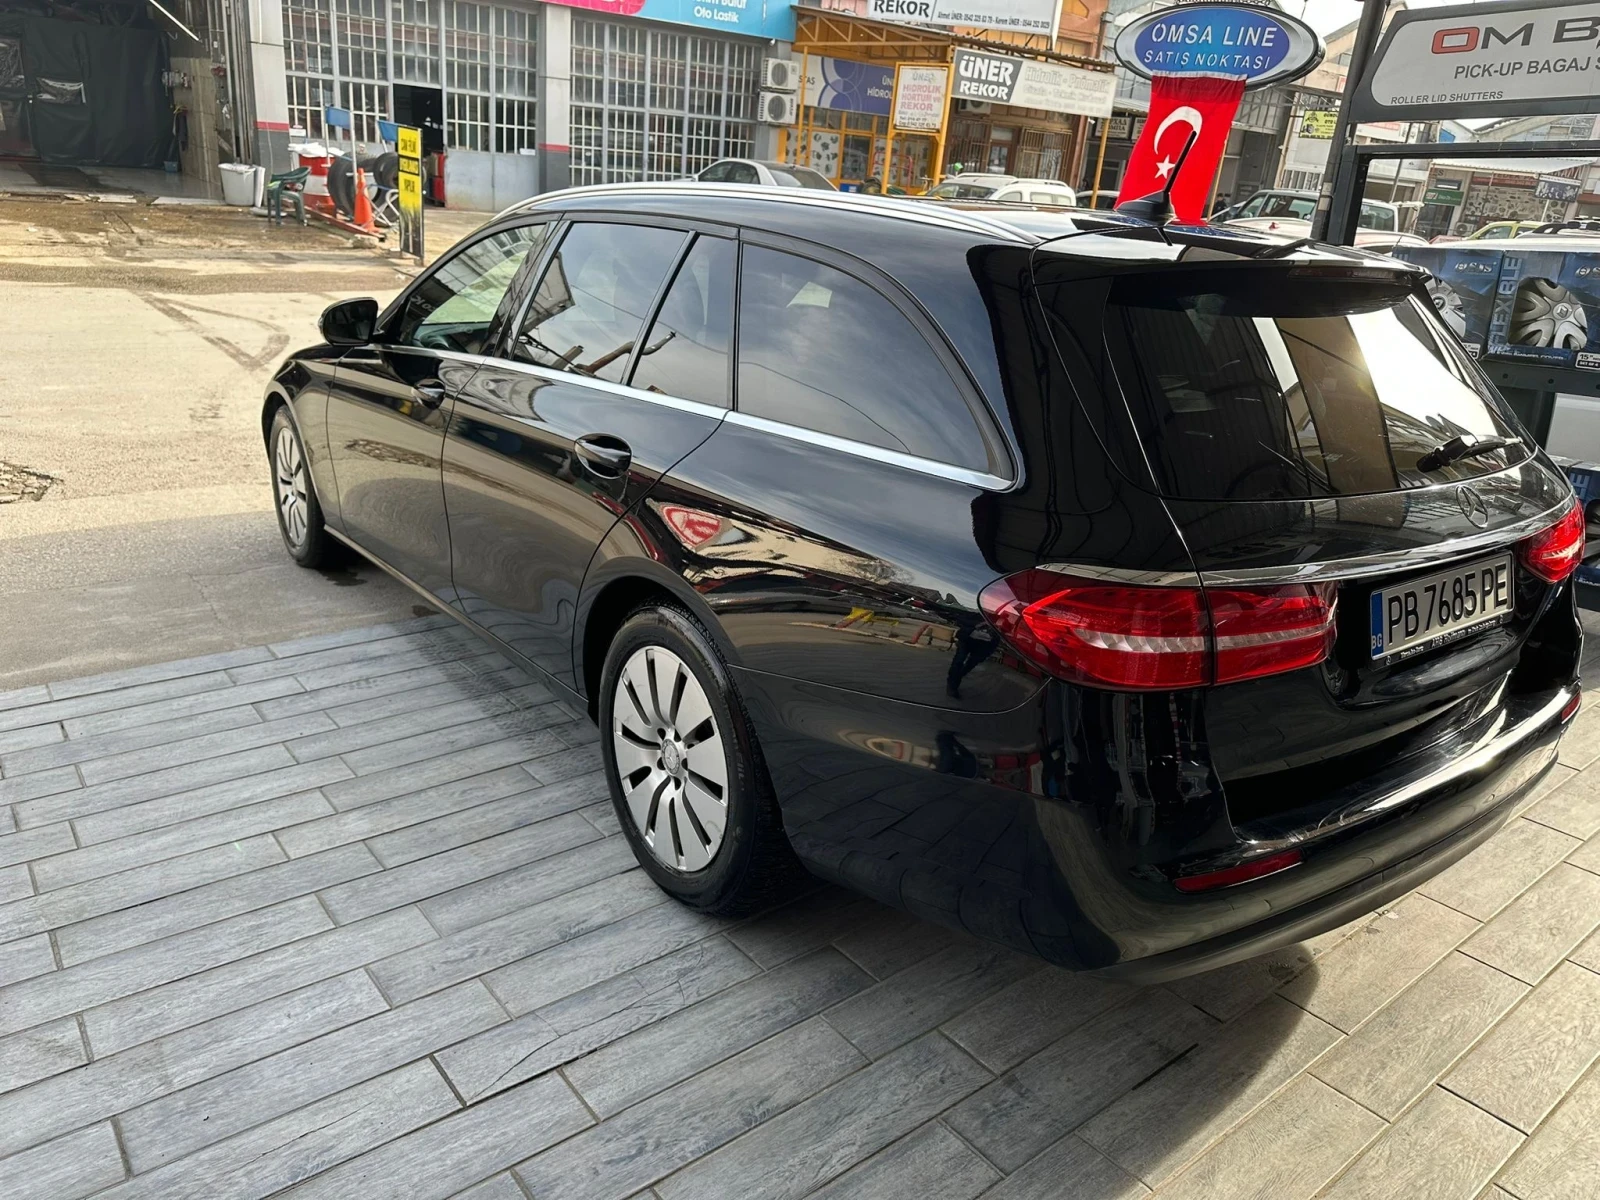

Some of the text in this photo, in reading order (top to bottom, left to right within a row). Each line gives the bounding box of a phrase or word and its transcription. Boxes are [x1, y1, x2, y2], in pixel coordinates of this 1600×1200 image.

[694, 6, 740, 23] Oto Lastik
[874, 0, 930, 18] REKOR
[1152, 23, 1278, 47] OMSA LINE
[1431, 16, 1600, 54] OM B
[1194, 53, 1270, 70] NOKTASI
[1454, 62, 1523, 79] PICK-UP
[1526, 56, 1591, 75] BAGAJ
[1025, 66, 1062, 86] Hidrolik
[1068, 74, 1110, 94] Pnömatik
[960, 80, 1008, 100] REKOR
[1390, 91, 1504, 105] ROLLER LID SHUTTERS
[900, 102, 933, 111] REKOR
[1388, 563, 1508, 646] PB 7685 PE
[1372, 634, 1383, 650] BG
